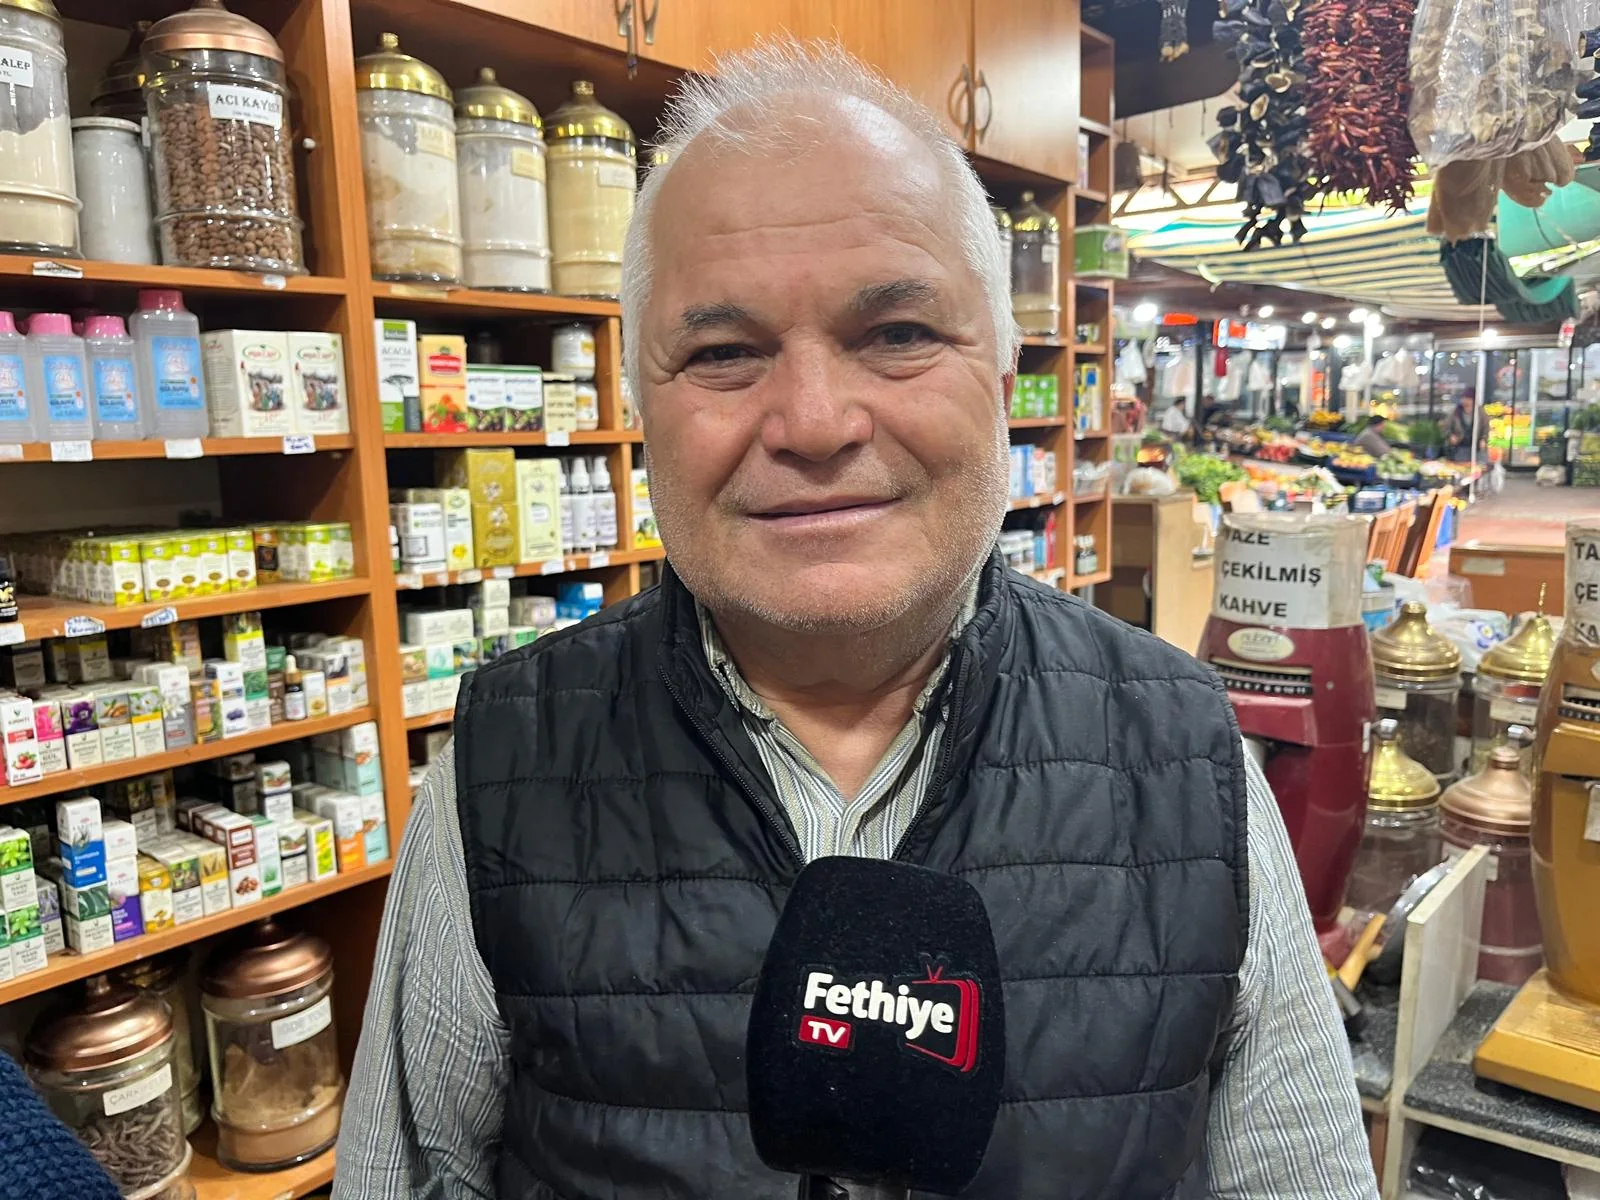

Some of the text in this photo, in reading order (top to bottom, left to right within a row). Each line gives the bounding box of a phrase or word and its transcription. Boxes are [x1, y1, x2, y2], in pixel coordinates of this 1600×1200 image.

[215, 94, 238, 106] ACI
[381, 346, 412, 356] ACACIA
[1221, 560, 1322, 588] ÇEKİLMİŞ
[1219, 593, 1288, 618] KAHVE
[803, 971, 955, 1040] Fethiye
[807, 1020, 847, 1044] TV
